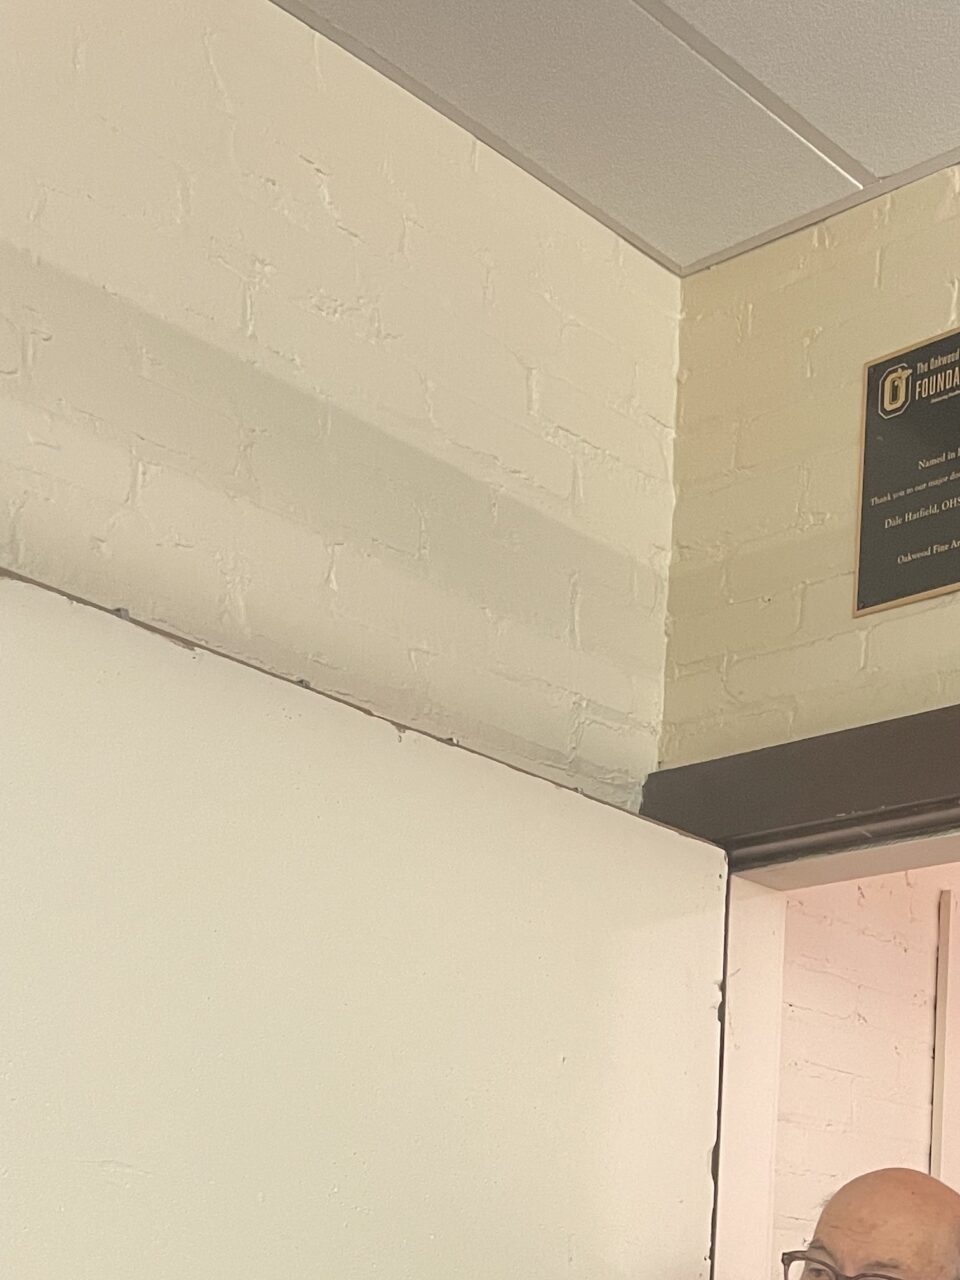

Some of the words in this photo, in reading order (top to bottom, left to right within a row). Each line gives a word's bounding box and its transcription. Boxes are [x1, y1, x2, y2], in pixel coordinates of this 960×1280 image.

[918, 453, 945, 470] Named
[948, 451, 956, 459] in
[871, 492, 892, 506] Thank
[915, 483, 927, 492] our
[928, 476, 949, 488] major
[885, 517, 903, 529] Dale
[905, 505, 939, 521] Hatfield,
[897, 546, 931, 564] Oakwood
[933, 543, 949, 554] Fine
